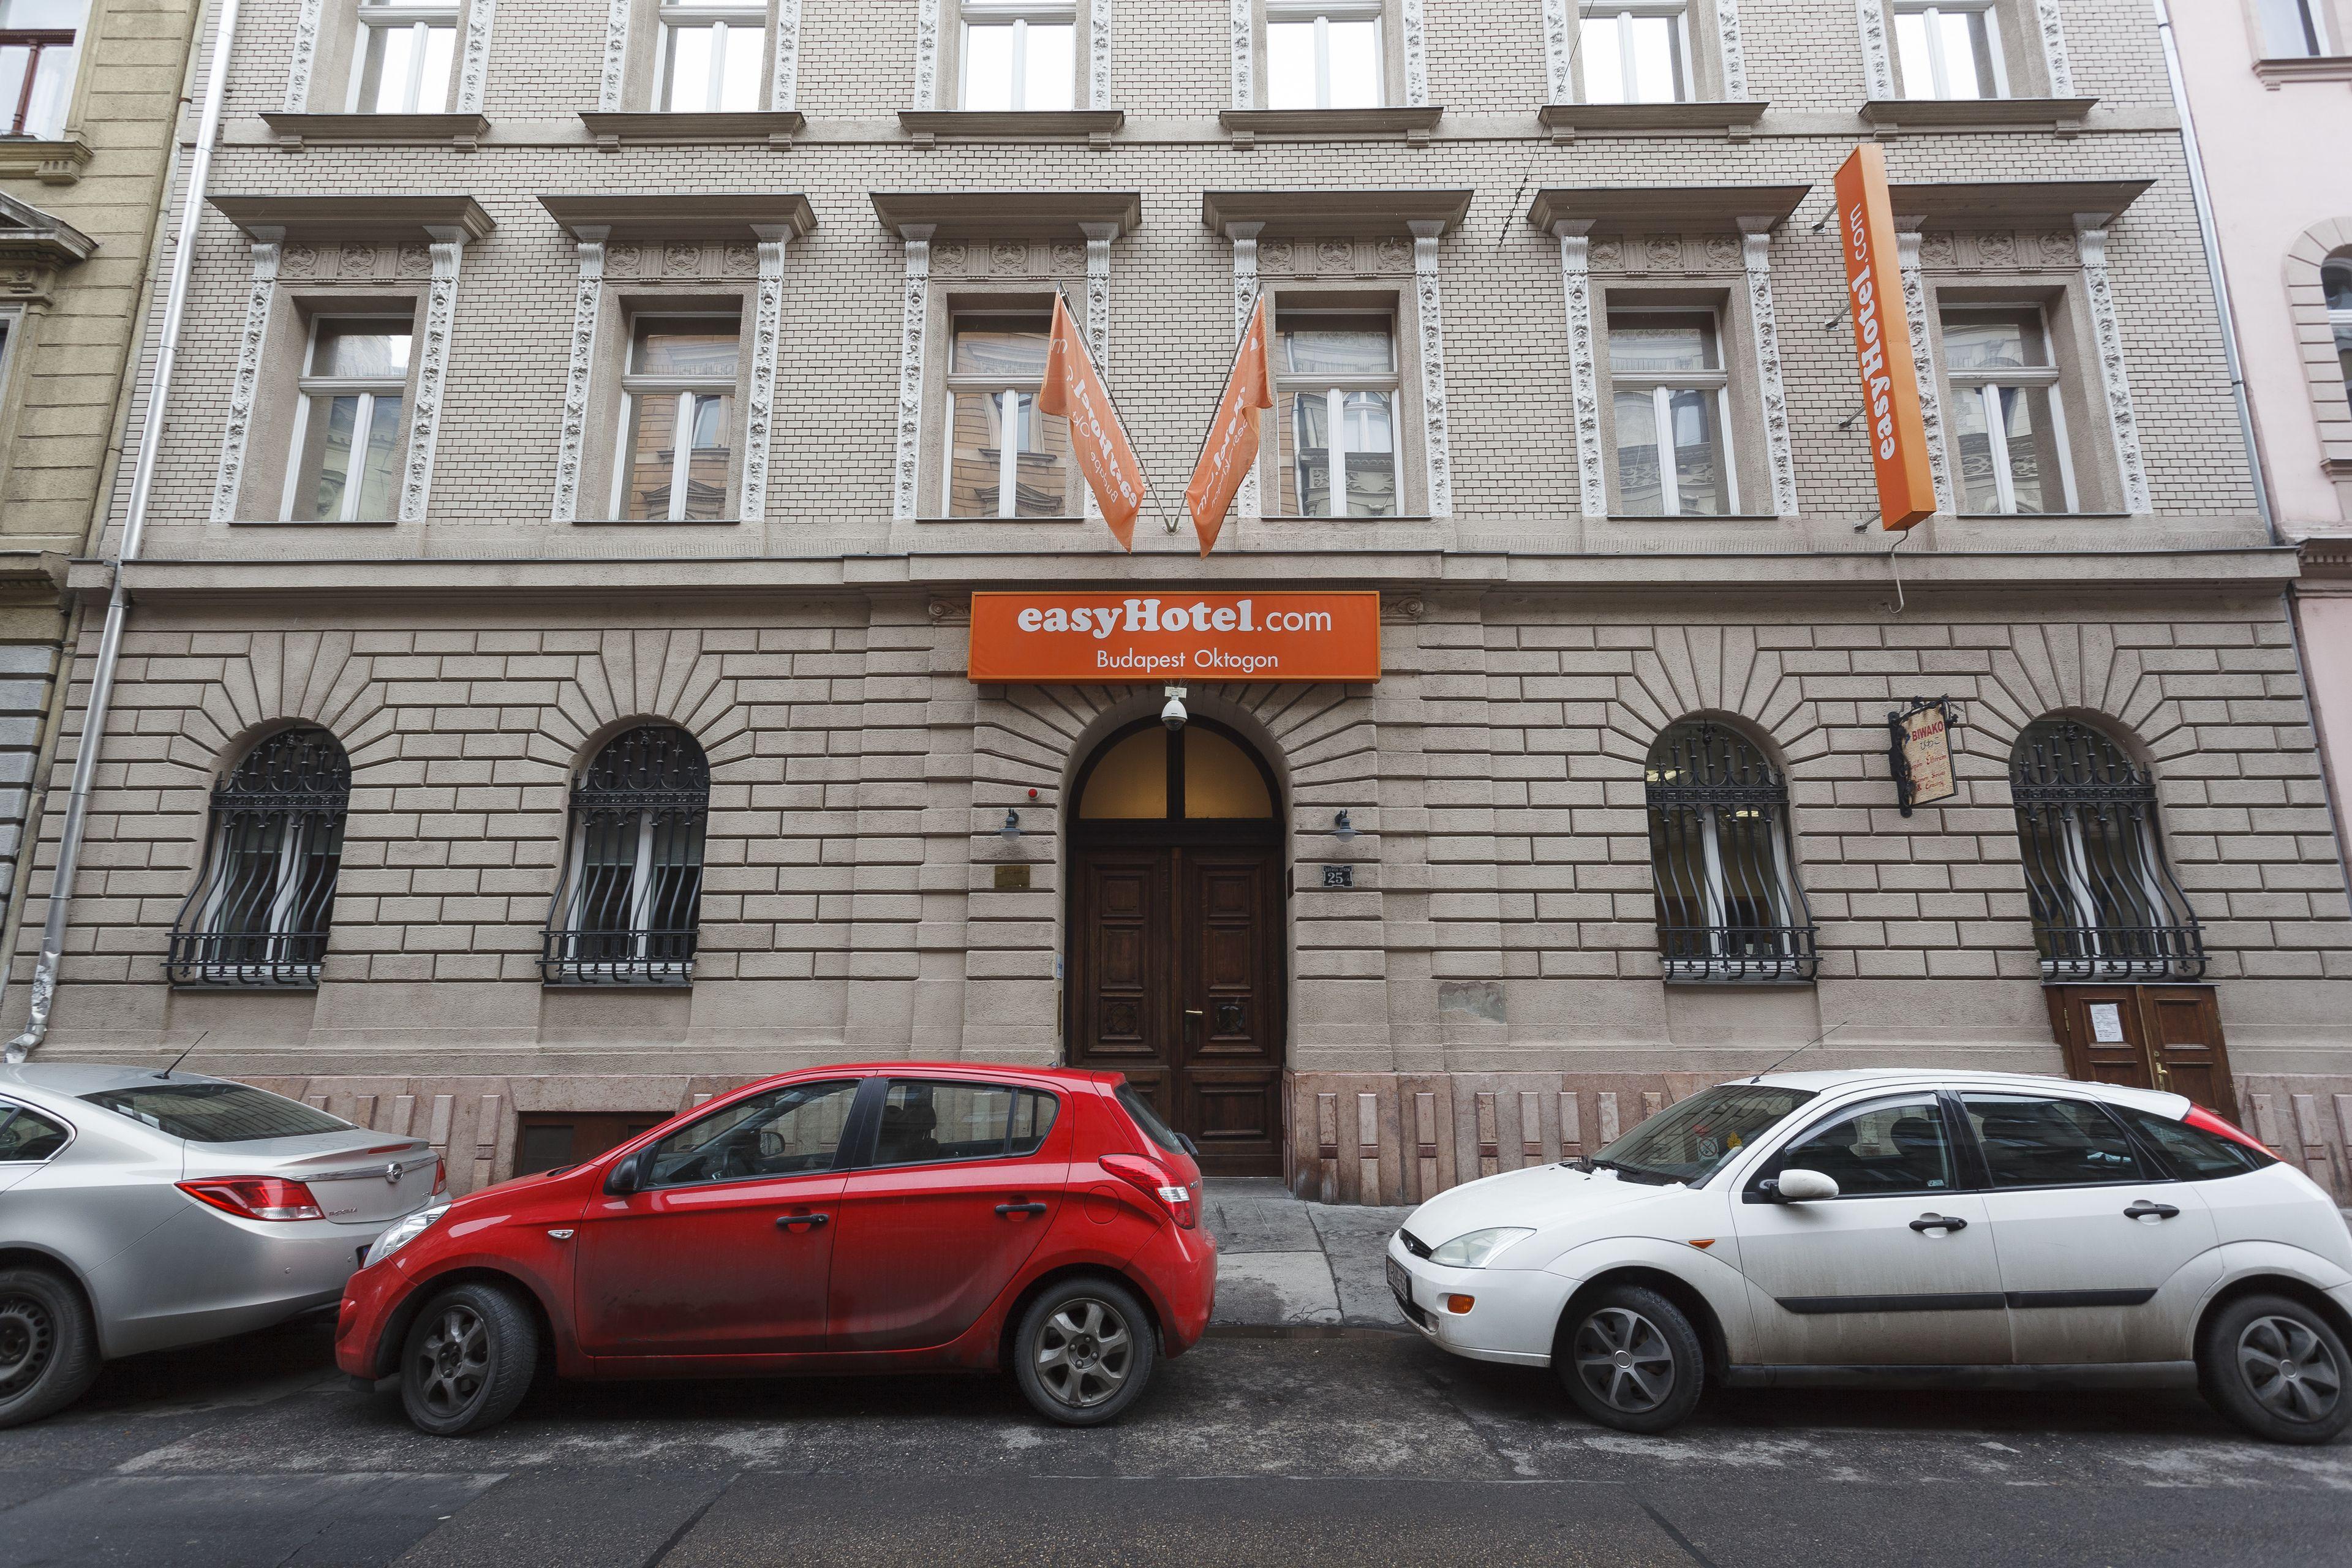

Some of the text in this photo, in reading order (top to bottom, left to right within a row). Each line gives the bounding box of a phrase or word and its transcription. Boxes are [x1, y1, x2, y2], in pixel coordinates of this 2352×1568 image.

[1848, 202, 1895, 461] easyHotel.com
[1017, 598, 1332, 639] easyHotel.com
[1097, 647, 1279, 673] Budapest Oktogon
[1912, 721, 1943, 741] BIWAKO
